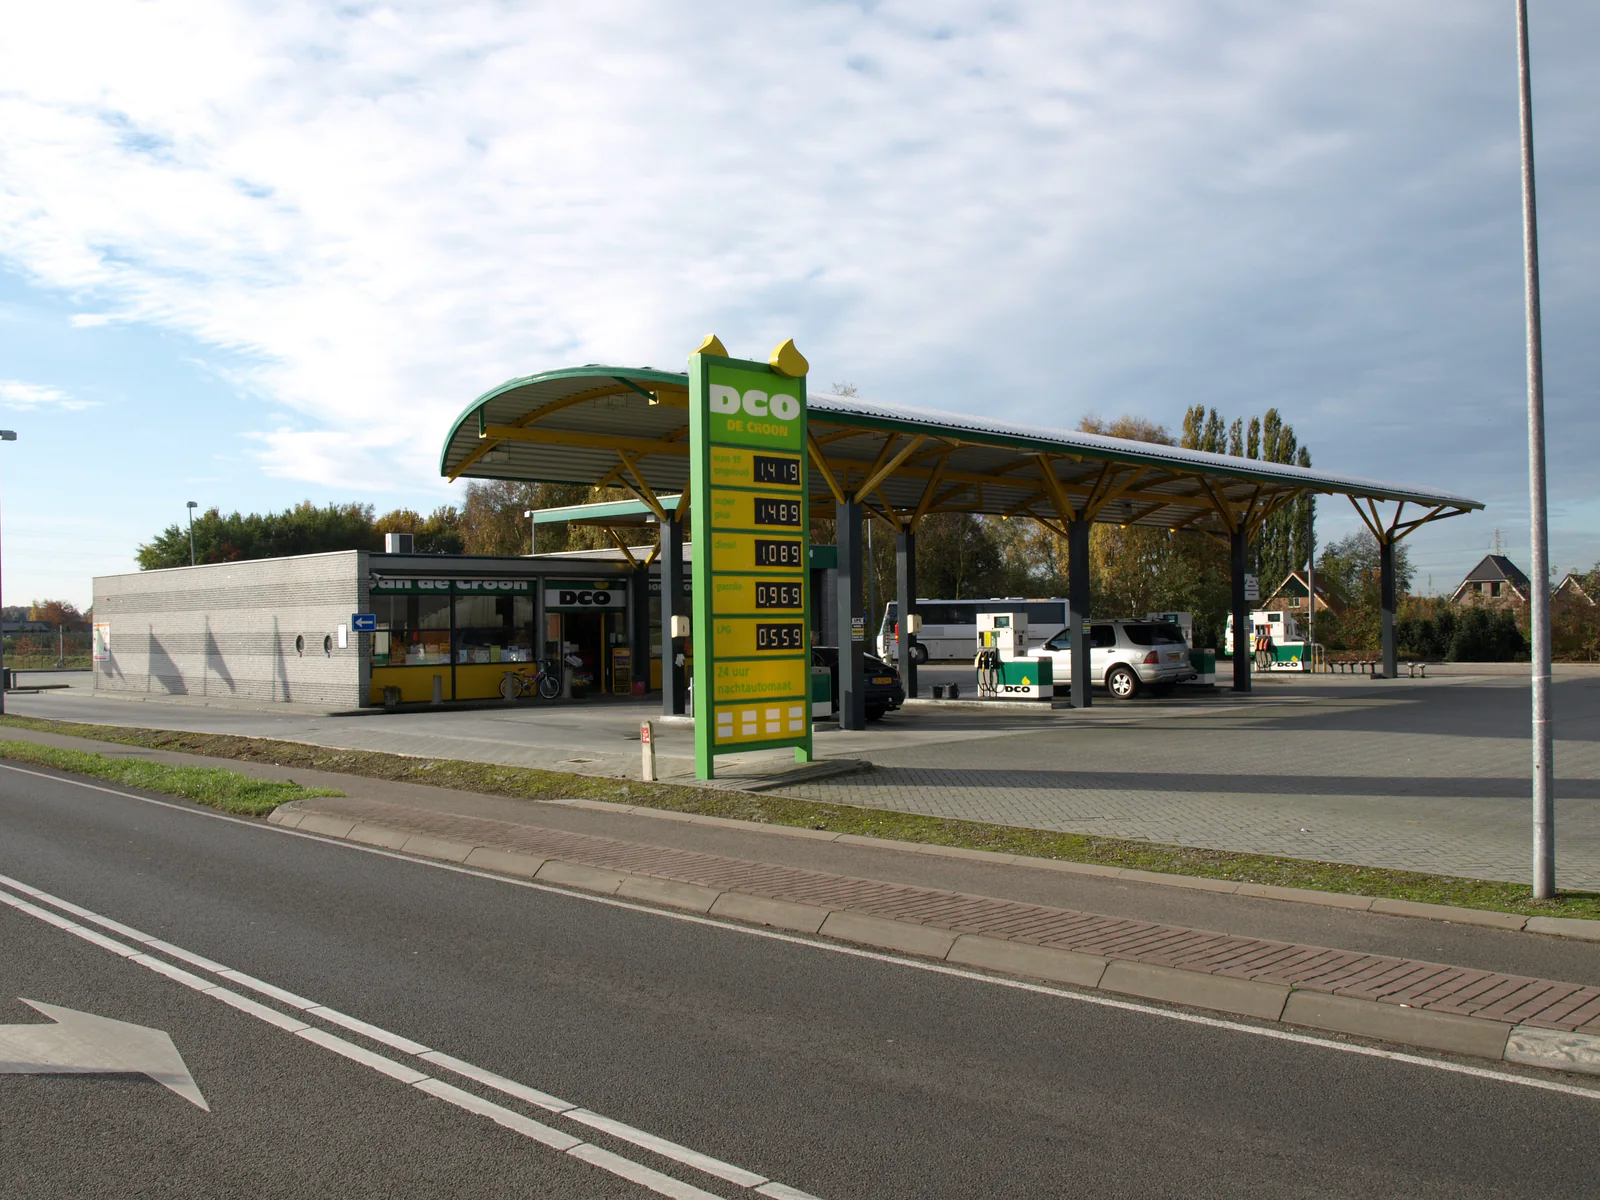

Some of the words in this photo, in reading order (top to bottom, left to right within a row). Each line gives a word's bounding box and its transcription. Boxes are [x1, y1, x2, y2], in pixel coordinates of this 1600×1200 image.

[710, 384, 800, 420] DCO
[727, 419, 744, 431] DE
[747, 422, 788, 436] CROON
[559, 590, 611, 605] DCO
[717, 626, 731, 634] LPG
[718, 667, 728, 677] 24
[732, 668, 750, 676] uur
[718, 681, 792, 694] nachtautomaat
